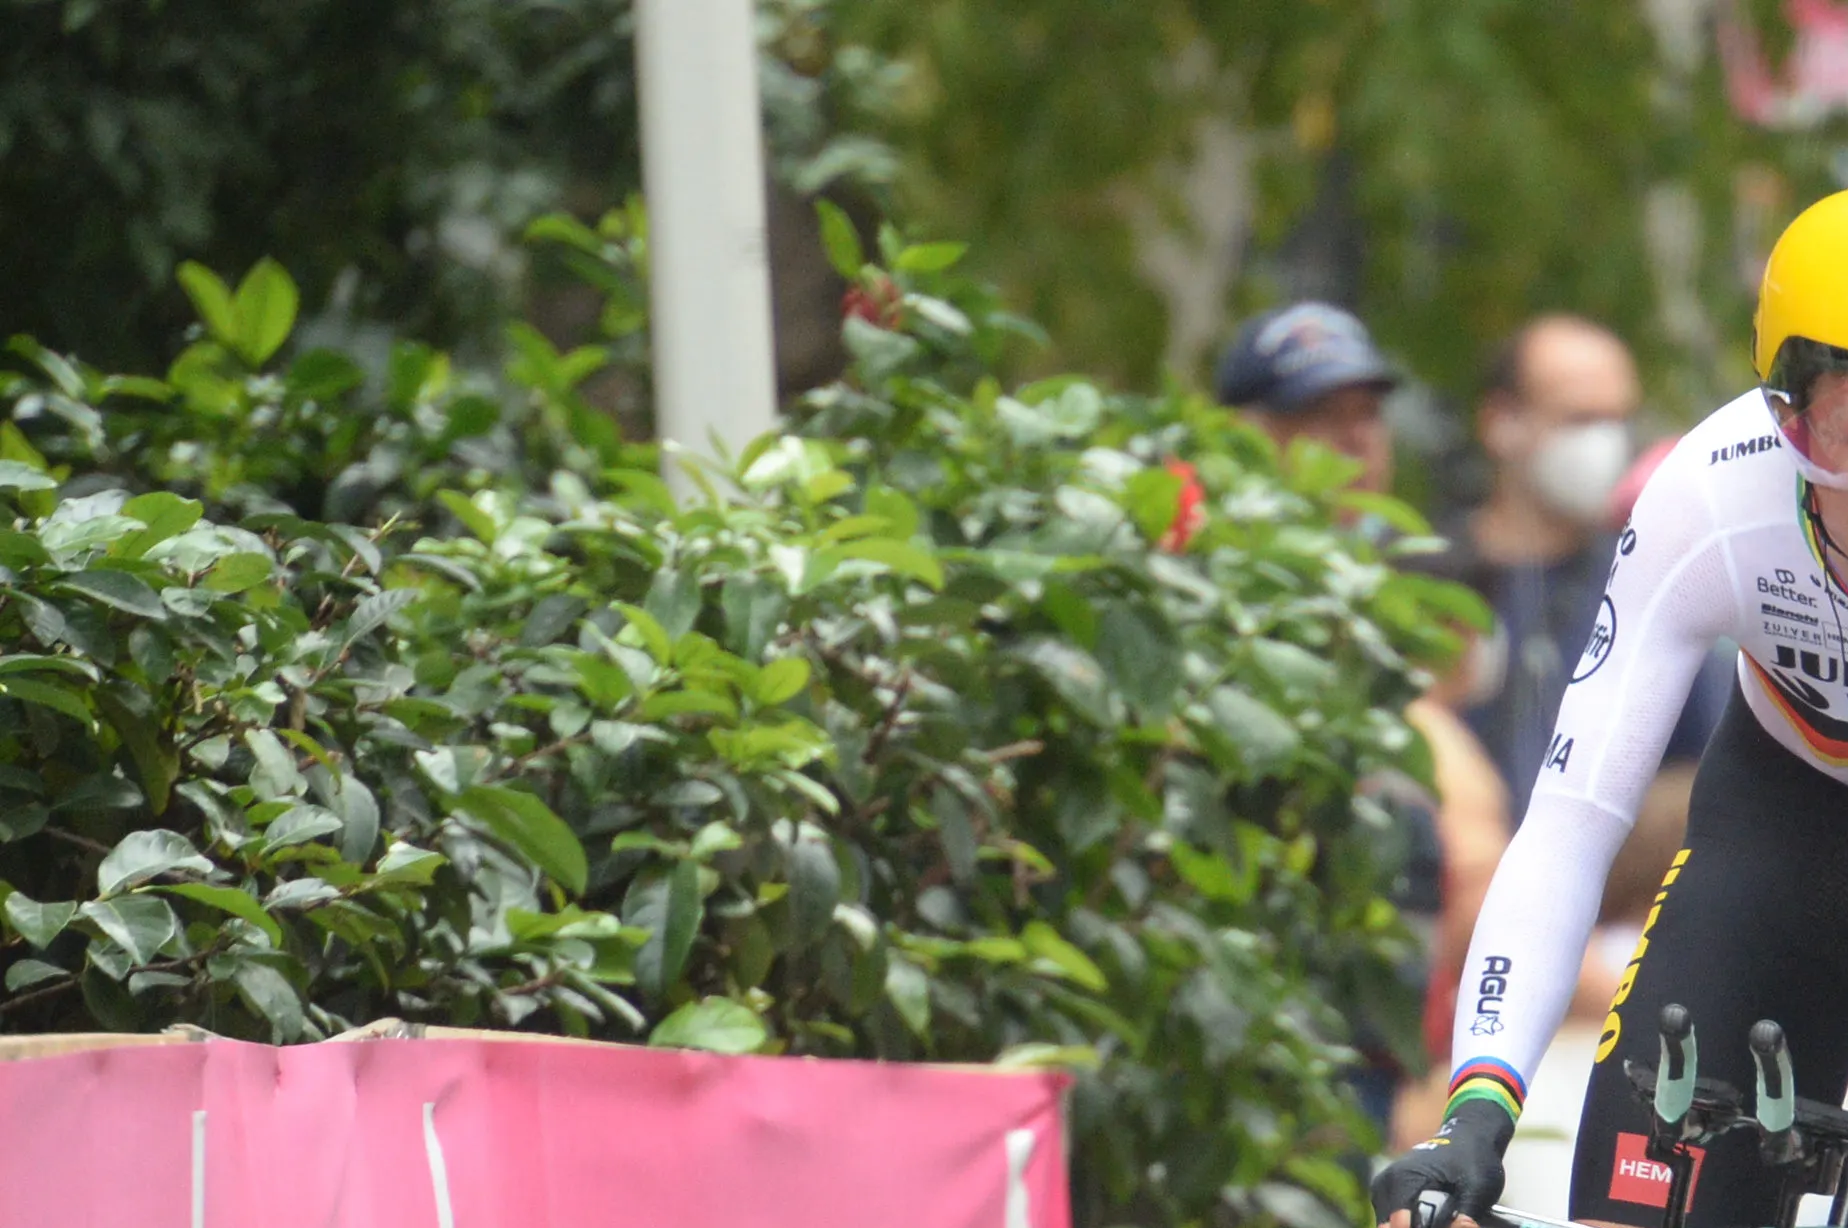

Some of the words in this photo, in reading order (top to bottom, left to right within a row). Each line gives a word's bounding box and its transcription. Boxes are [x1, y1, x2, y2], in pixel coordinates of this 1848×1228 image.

[1763, 621, 1822, 641] ZUIVER
[1476, 955, 1512, 1015] AGU
[1619, 1158, 1673, 1184] HEM
